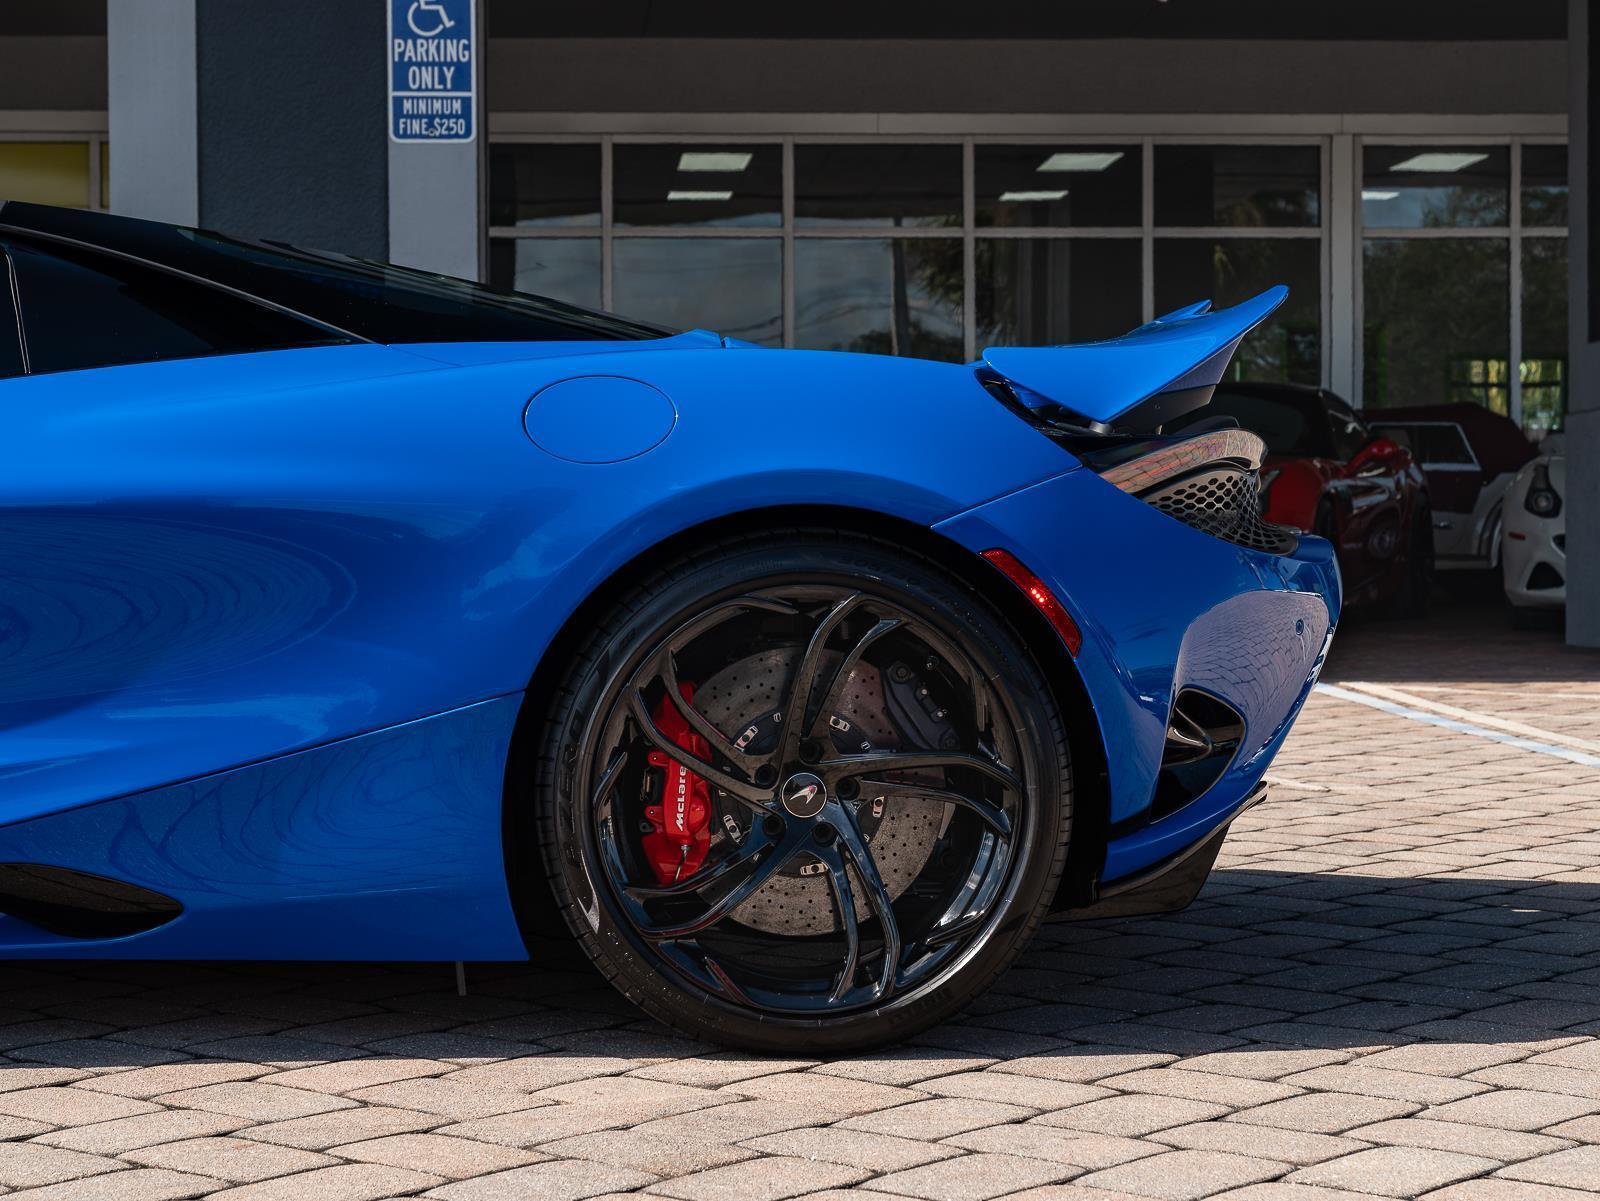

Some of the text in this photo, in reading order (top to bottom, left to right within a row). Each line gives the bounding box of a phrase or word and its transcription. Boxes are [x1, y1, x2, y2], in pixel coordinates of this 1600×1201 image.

[394, 38, 470, 62] PARKING
[408, 66, 455, 89] ONLY
[403, 98, 462, 115] MINIMUM
[399, 117, 466, 136] FINE $250
[675, 765, 688, 832] McLare
